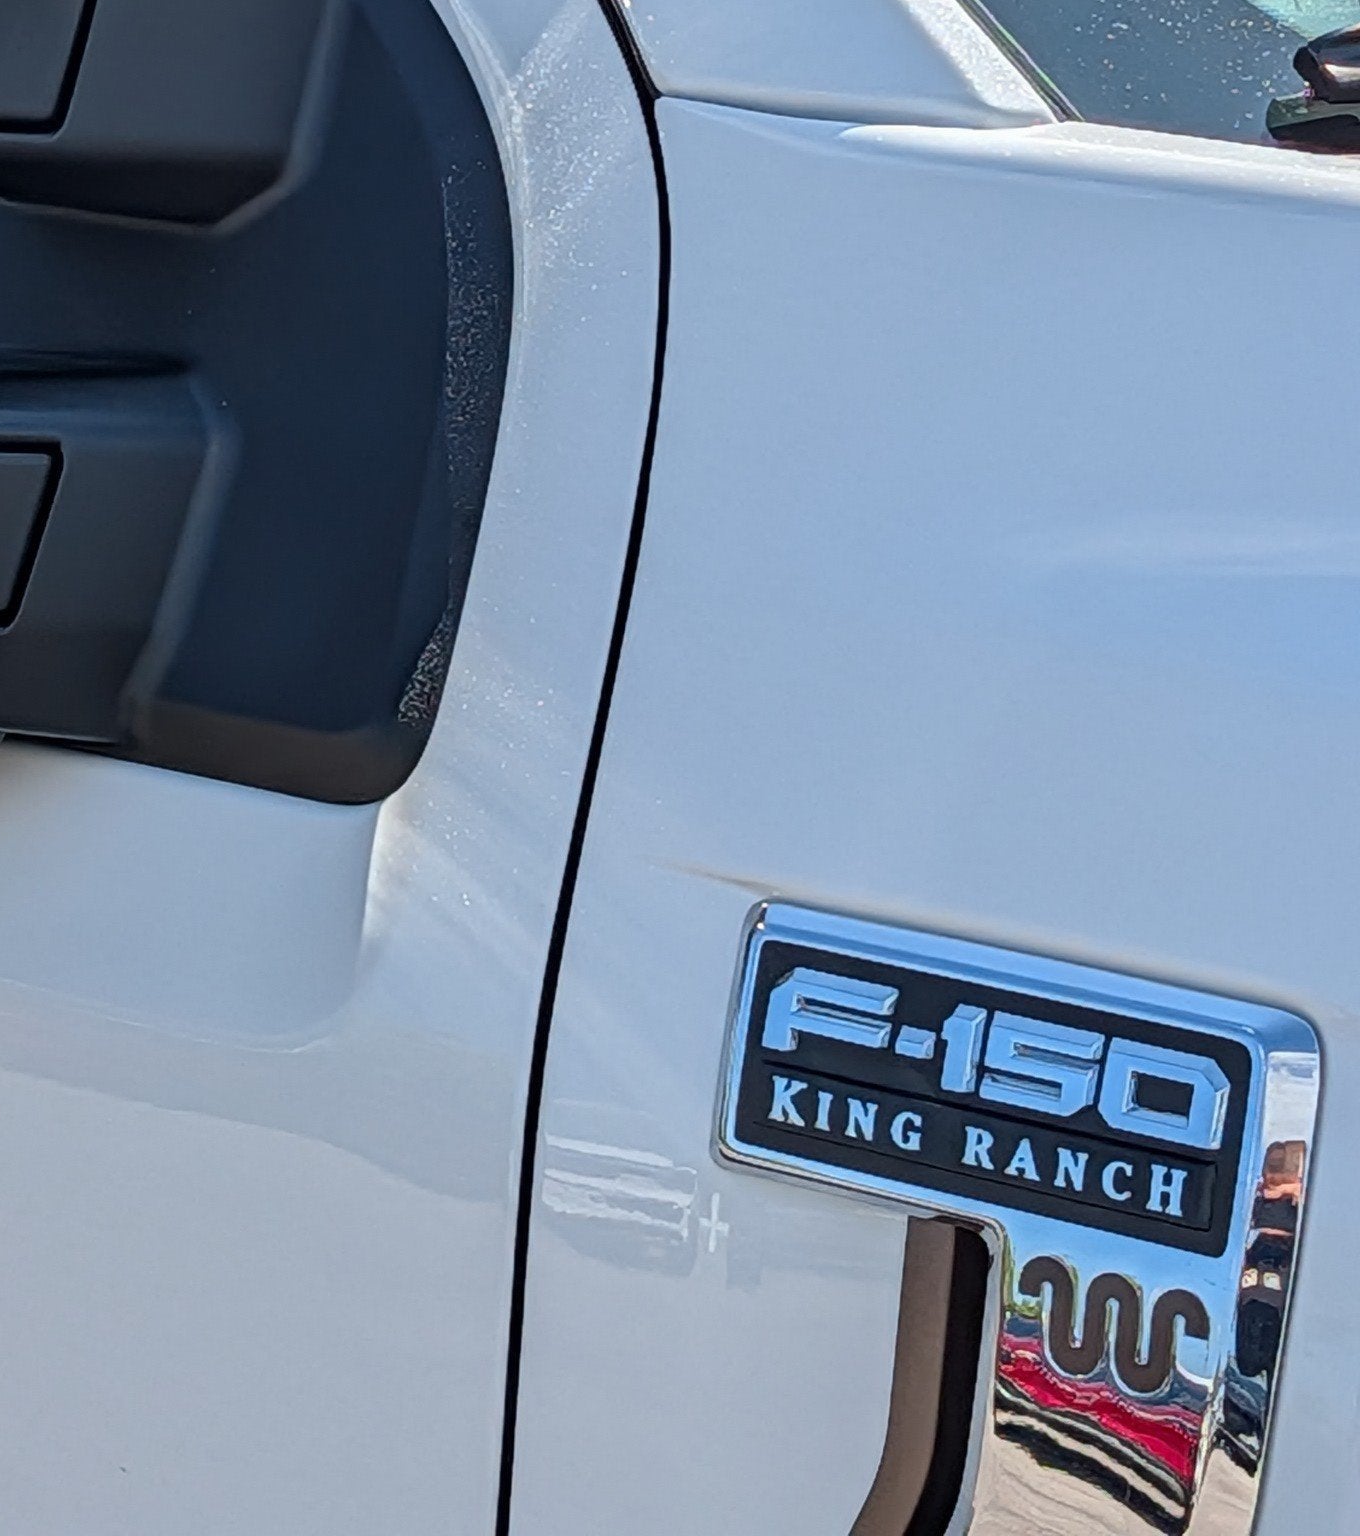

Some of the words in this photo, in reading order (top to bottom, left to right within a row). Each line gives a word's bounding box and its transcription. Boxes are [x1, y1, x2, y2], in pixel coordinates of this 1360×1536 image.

[761, 967, 1231, 1150] F-150
[768, 1075, 924, 1151] KING
[961, 1125, 1188, 1217] RANCH
